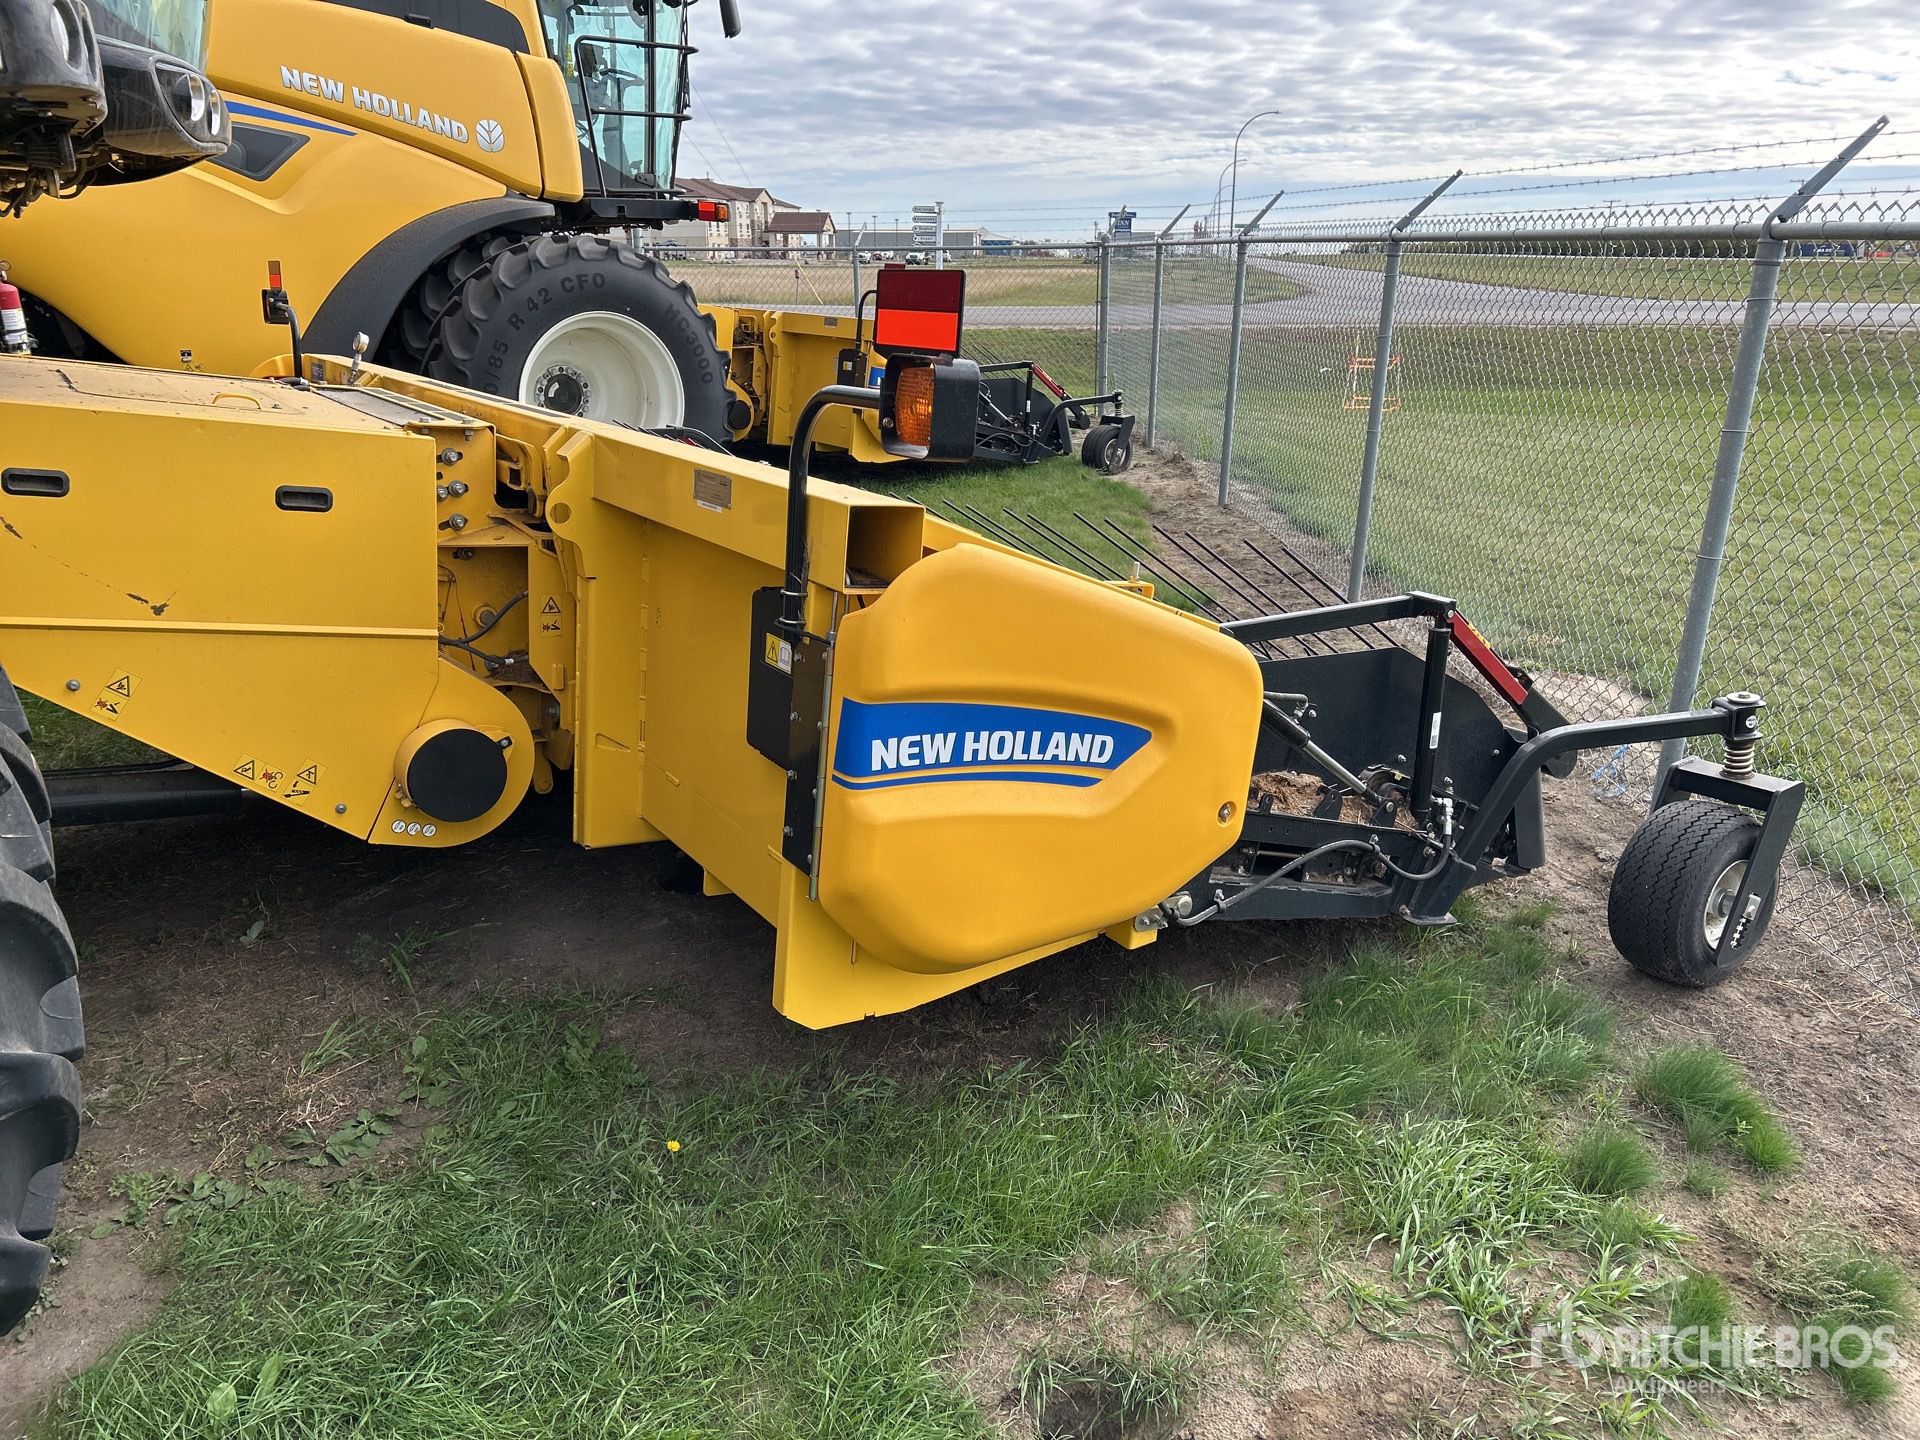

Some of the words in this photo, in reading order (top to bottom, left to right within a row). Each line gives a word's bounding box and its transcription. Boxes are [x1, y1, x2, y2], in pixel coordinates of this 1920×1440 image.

[280, 65, 345, 103] NEW
[351, 86, 469, 143] HOLLAND
[482, 338, 509, 394] 0/85
[506, 312, 526, 331] R
[526, 287, 553, 312] 42
[559, 272, 606, 293] CFO
[663, 302, 714, 384] HC3000
[871, 732, 957, 771] NEW
[963, 730, 1114, 763] HOLLAND
